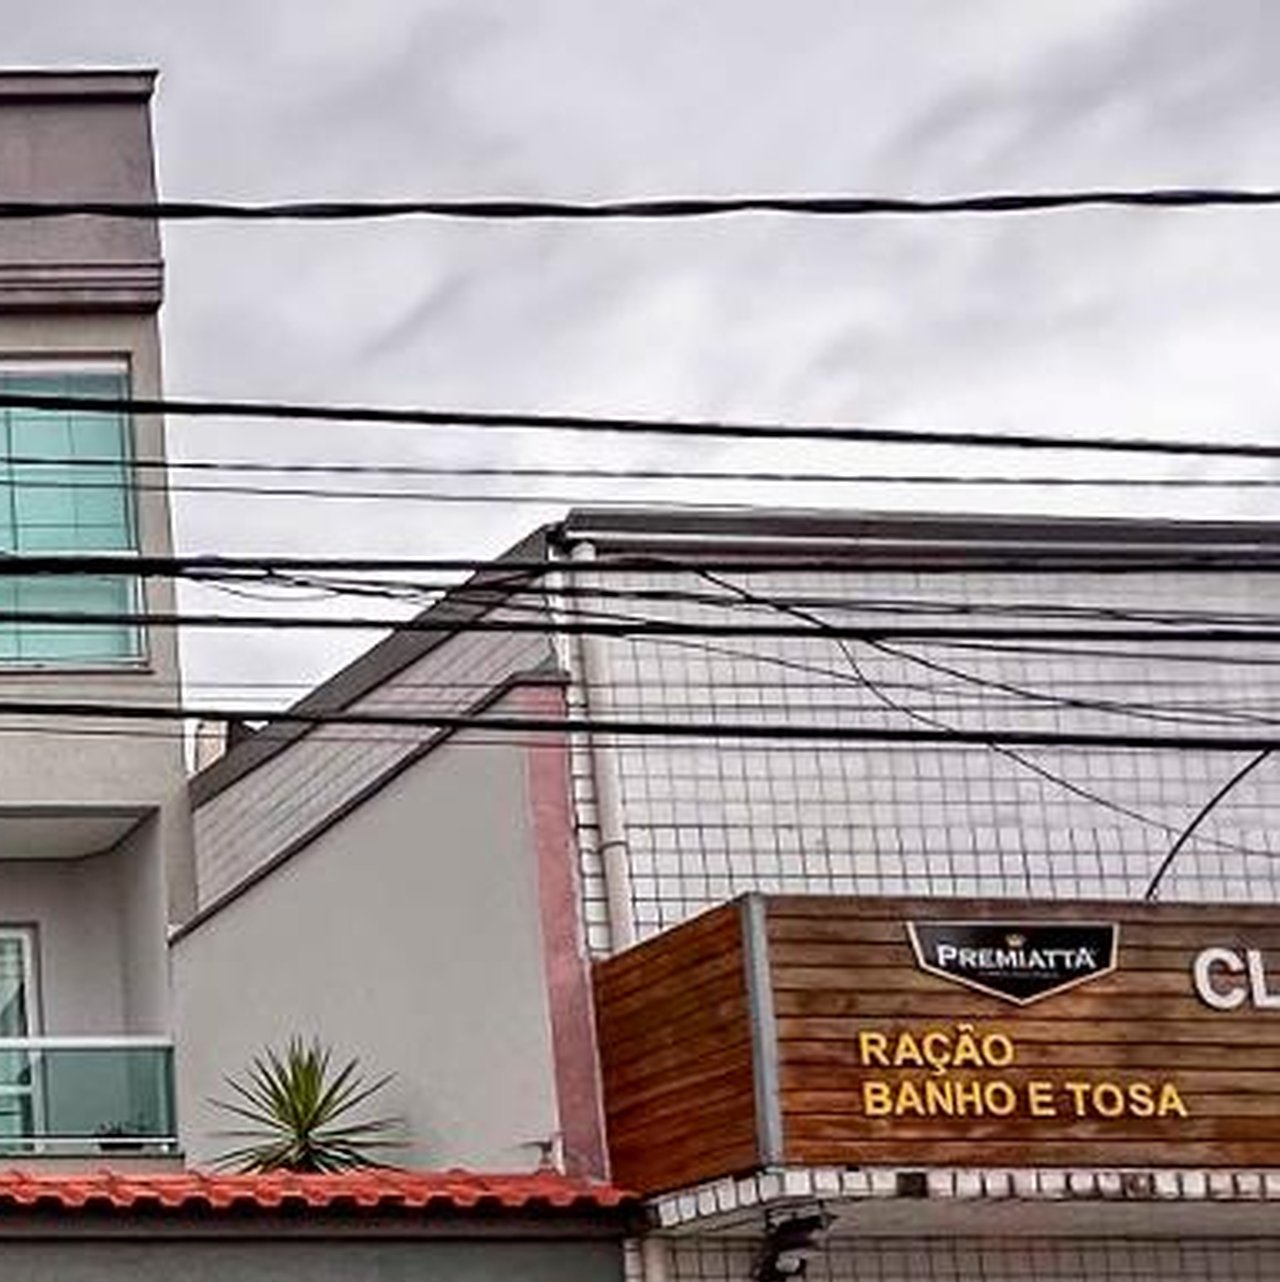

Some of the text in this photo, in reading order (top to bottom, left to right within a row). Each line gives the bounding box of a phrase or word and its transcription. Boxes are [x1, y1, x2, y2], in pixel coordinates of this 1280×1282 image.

[937, 944, 1096, 968] PREMIATTA
[859, 1023, 1015, 1076] RAÇÃO
[863, 1080, 1188, 1117] BANHO E TOSA
